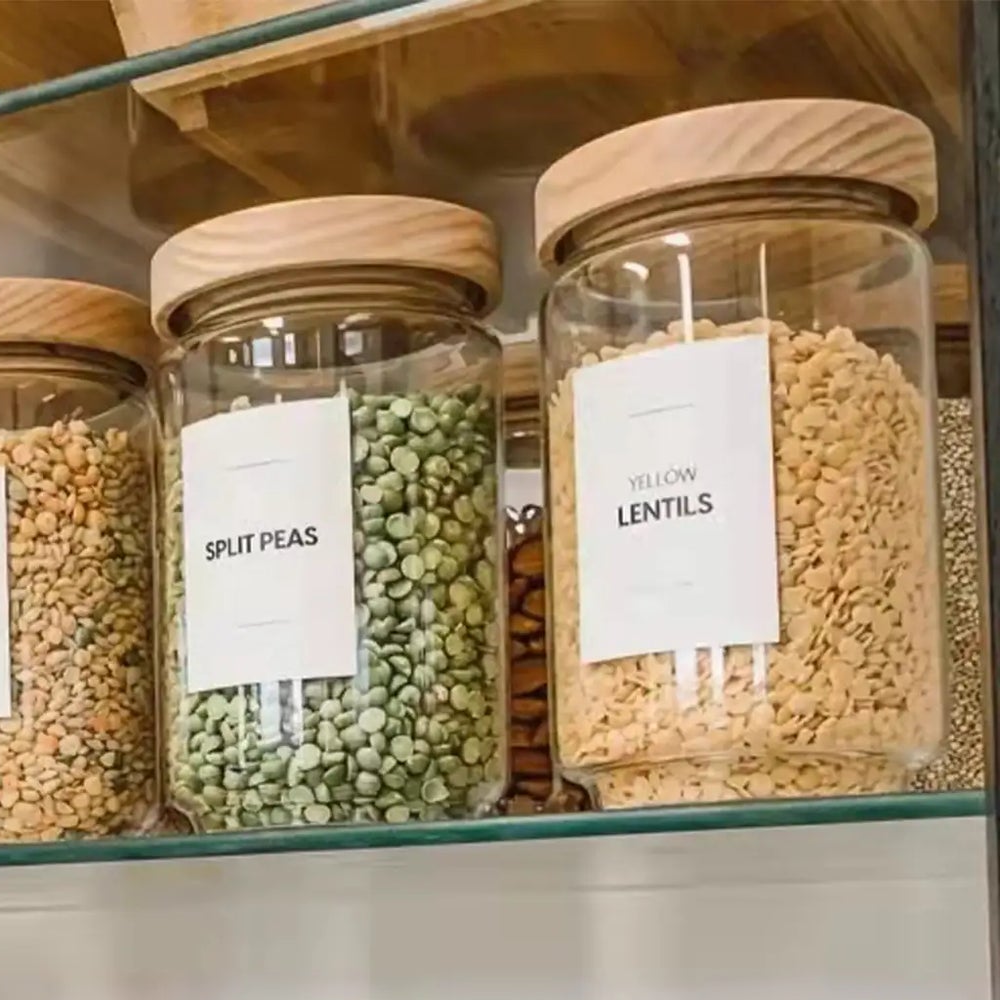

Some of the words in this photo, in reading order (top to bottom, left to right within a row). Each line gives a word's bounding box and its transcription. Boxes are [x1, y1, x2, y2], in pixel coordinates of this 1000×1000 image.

[628, 466, 698, 492] YELLOW
[618, 493, 714, 528] LENTILS
[205, 533, 255, 561] SPLIT
[261, 526, 318, 551] PEAS
